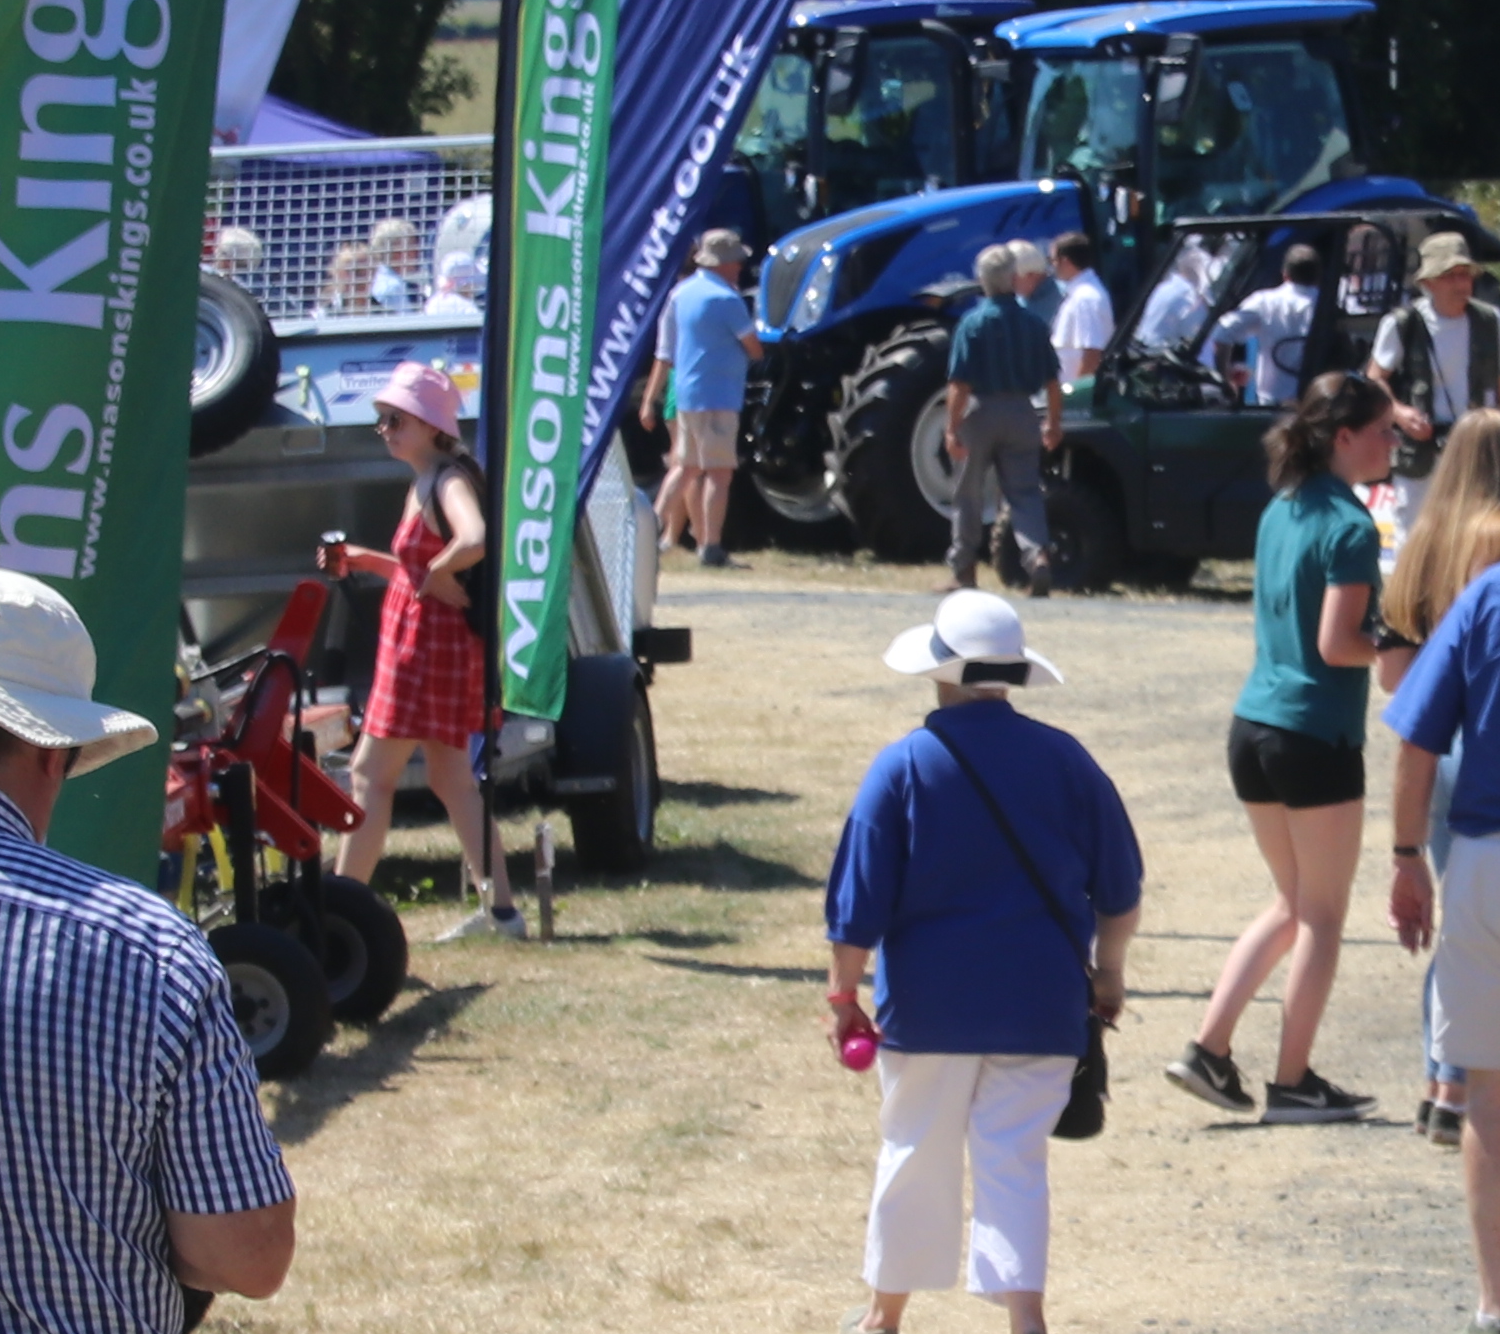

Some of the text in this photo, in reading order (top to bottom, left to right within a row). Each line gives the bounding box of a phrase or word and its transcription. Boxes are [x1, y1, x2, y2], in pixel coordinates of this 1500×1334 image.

[77, 75, 160, 583] www.masonskings.co.uk
[566, 81, 597, 399] www.masonskings.co.uk
[579, 33, 762, 448] www.iwt.co.uk
[504, 283, 570, 681] Masons
